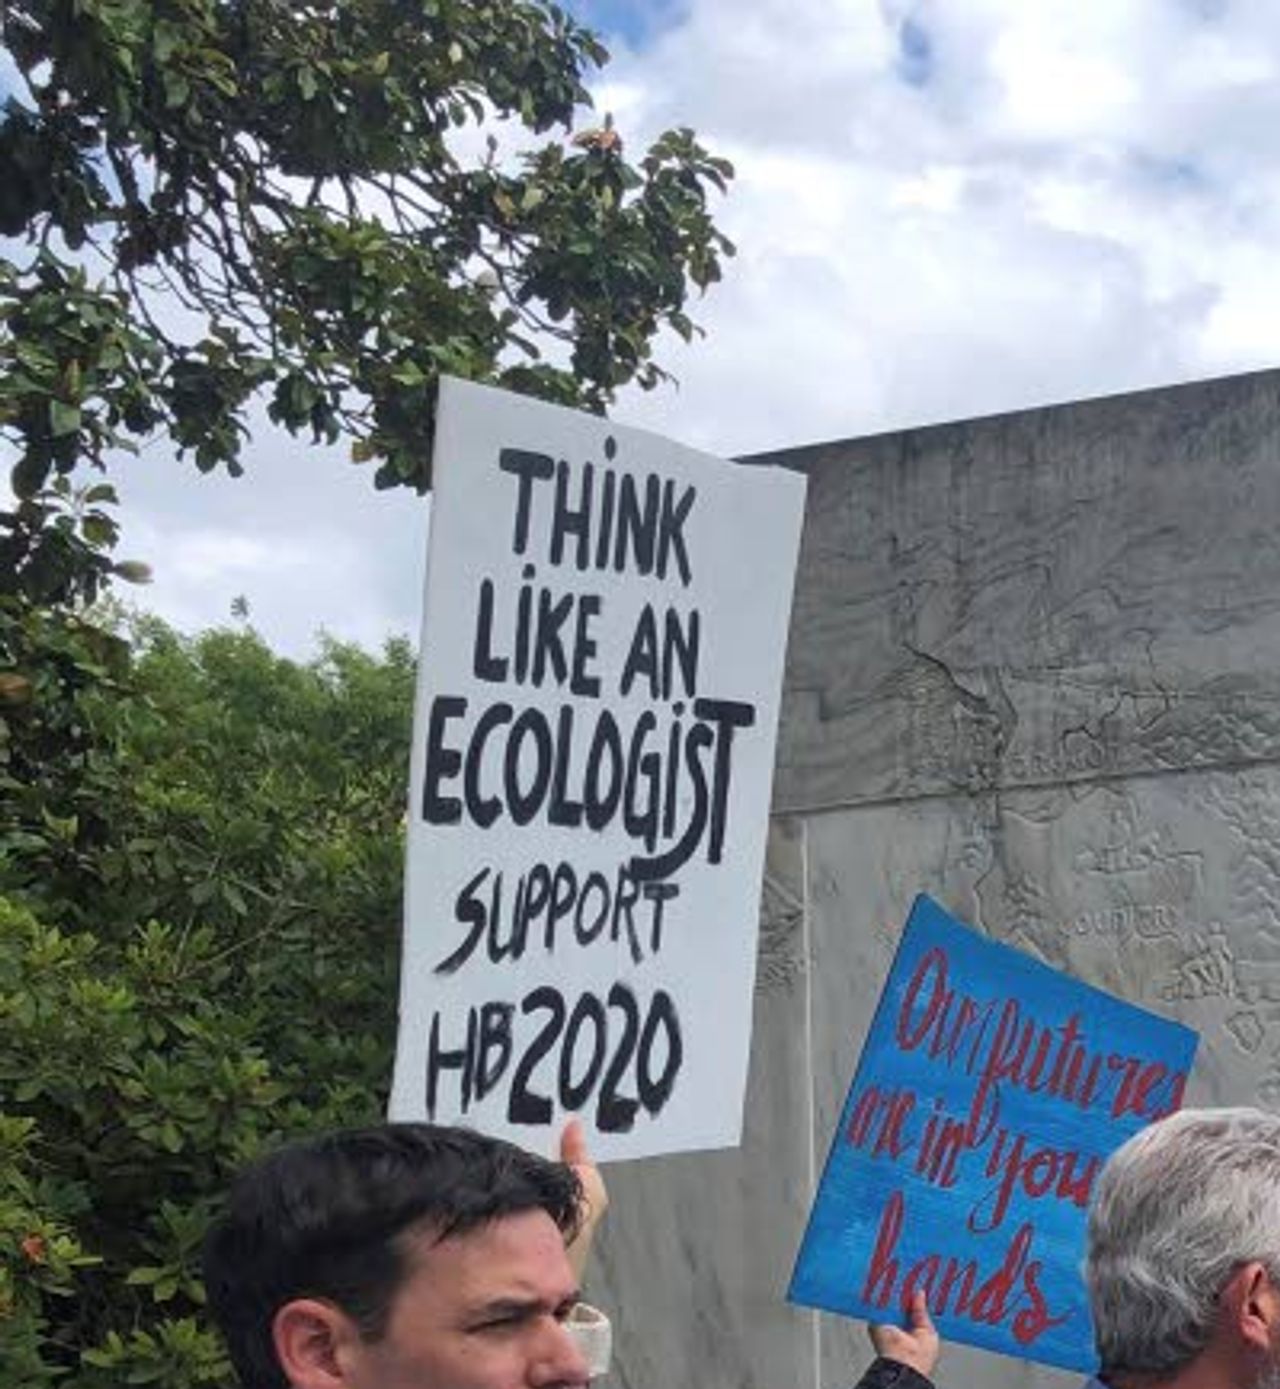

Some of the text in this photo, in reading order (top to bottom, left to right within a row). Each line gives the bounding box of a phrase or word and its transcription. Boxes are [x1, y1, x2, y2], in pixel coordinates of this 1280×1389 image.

[499, 436, 696, 587] THINK
[474, 564, 699, 699] LIKE AN
[422, 695, 755, 881] ECOLOGIST
[433, 862, 680, 975] SUPPORT
[427, 981, 683, 1134] HB2020
[897, 946, 995, 1076] Our
[916, 1102, 966, 1188] in
[862, 1190, 1077, 1346] hands
